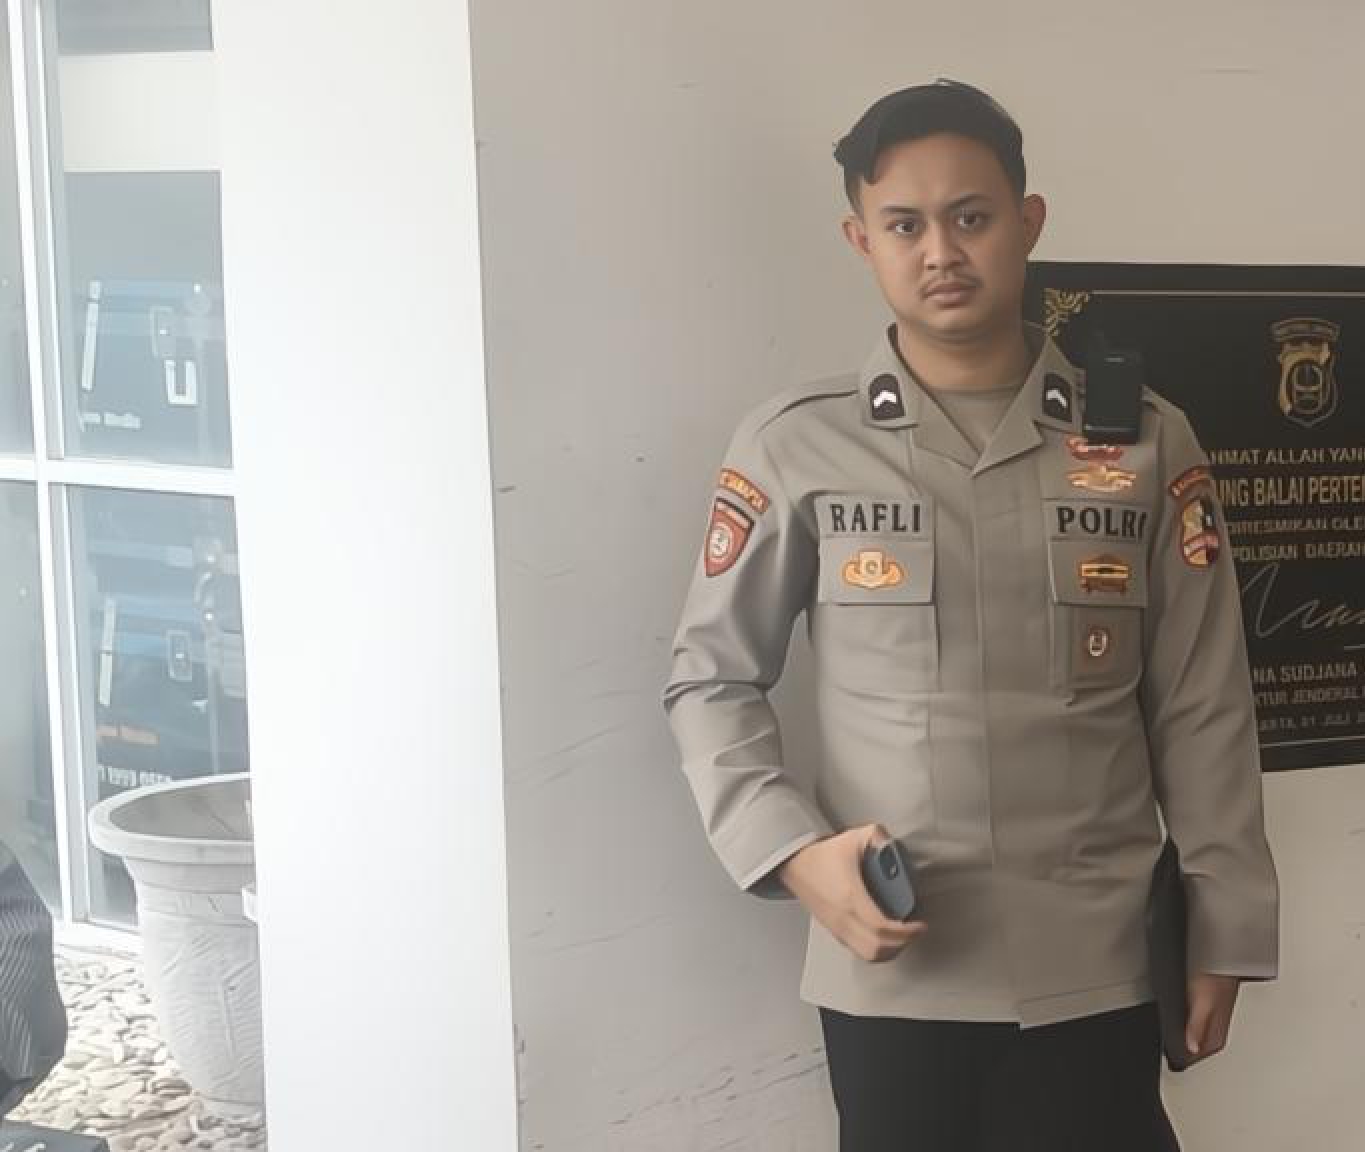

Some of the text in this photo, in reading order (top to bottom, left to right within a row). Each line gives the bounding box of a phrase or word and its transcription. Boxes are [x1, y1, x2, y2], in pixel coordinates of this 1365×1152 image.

[1207, 447, 1261, 465] HMAT
[1265, 447, 1325, 464] ALLAH
[1253, 475, 1305, 507] BALAI
[829, 502, 922, 533] RAFLI
[1055, 505, 1148, 540] POLRI
